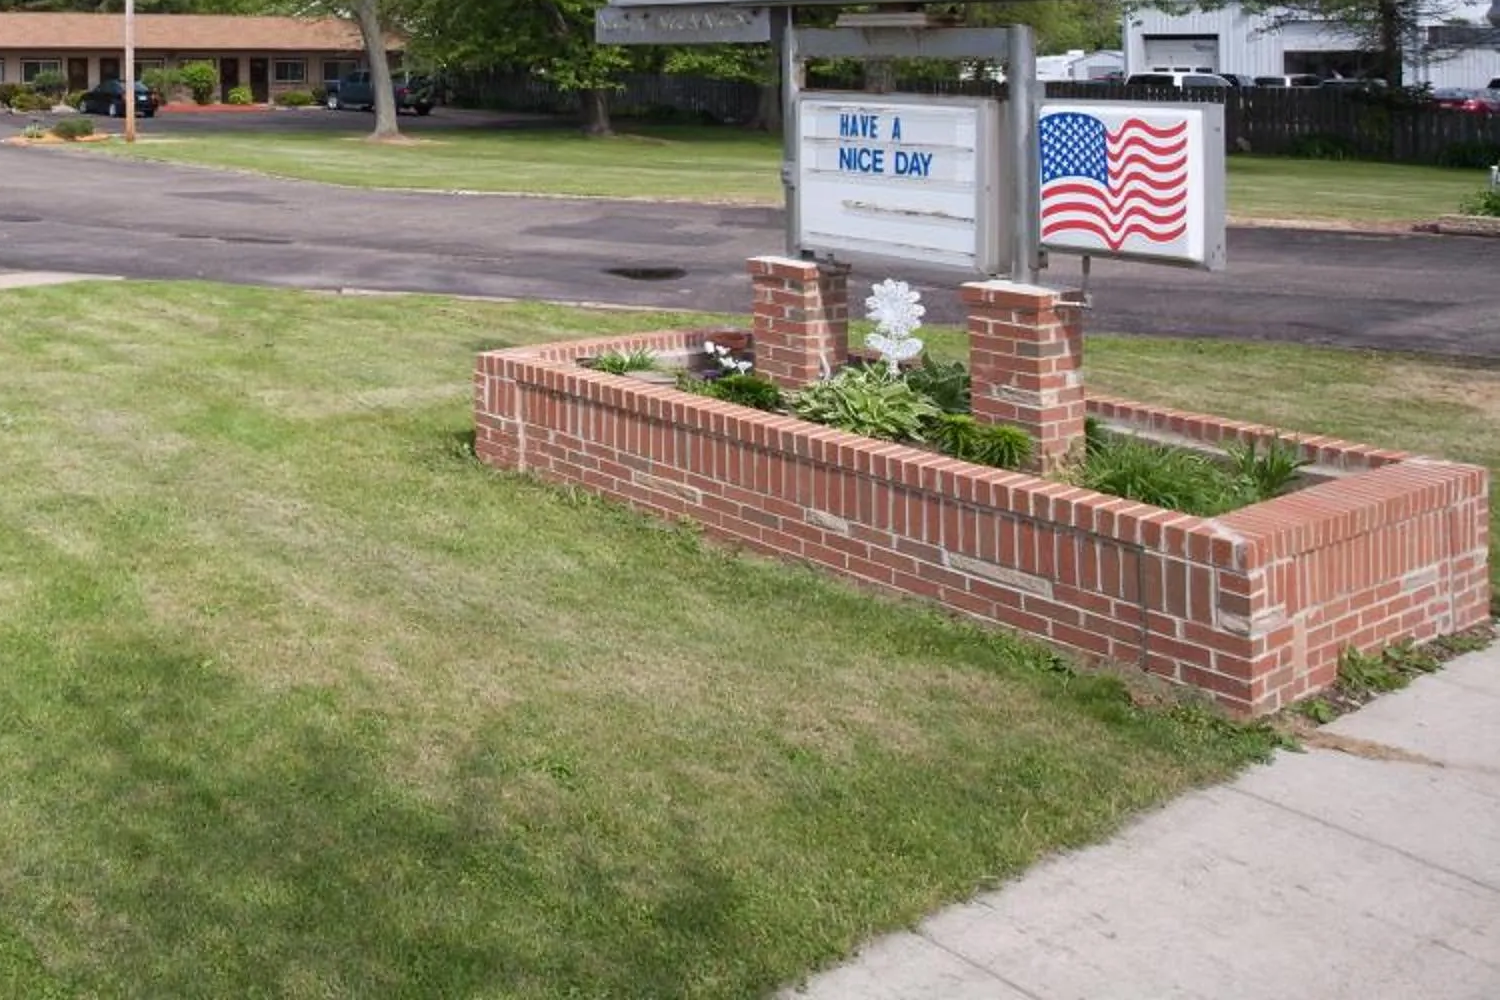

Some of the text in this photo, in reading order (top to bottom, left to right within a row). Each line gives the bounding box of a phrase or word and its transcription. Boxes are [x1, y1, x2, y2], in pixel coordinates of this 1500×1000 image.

[838, 113, 902, 141] HAVE A
[837, 147, 933, 177] NICE DAY
